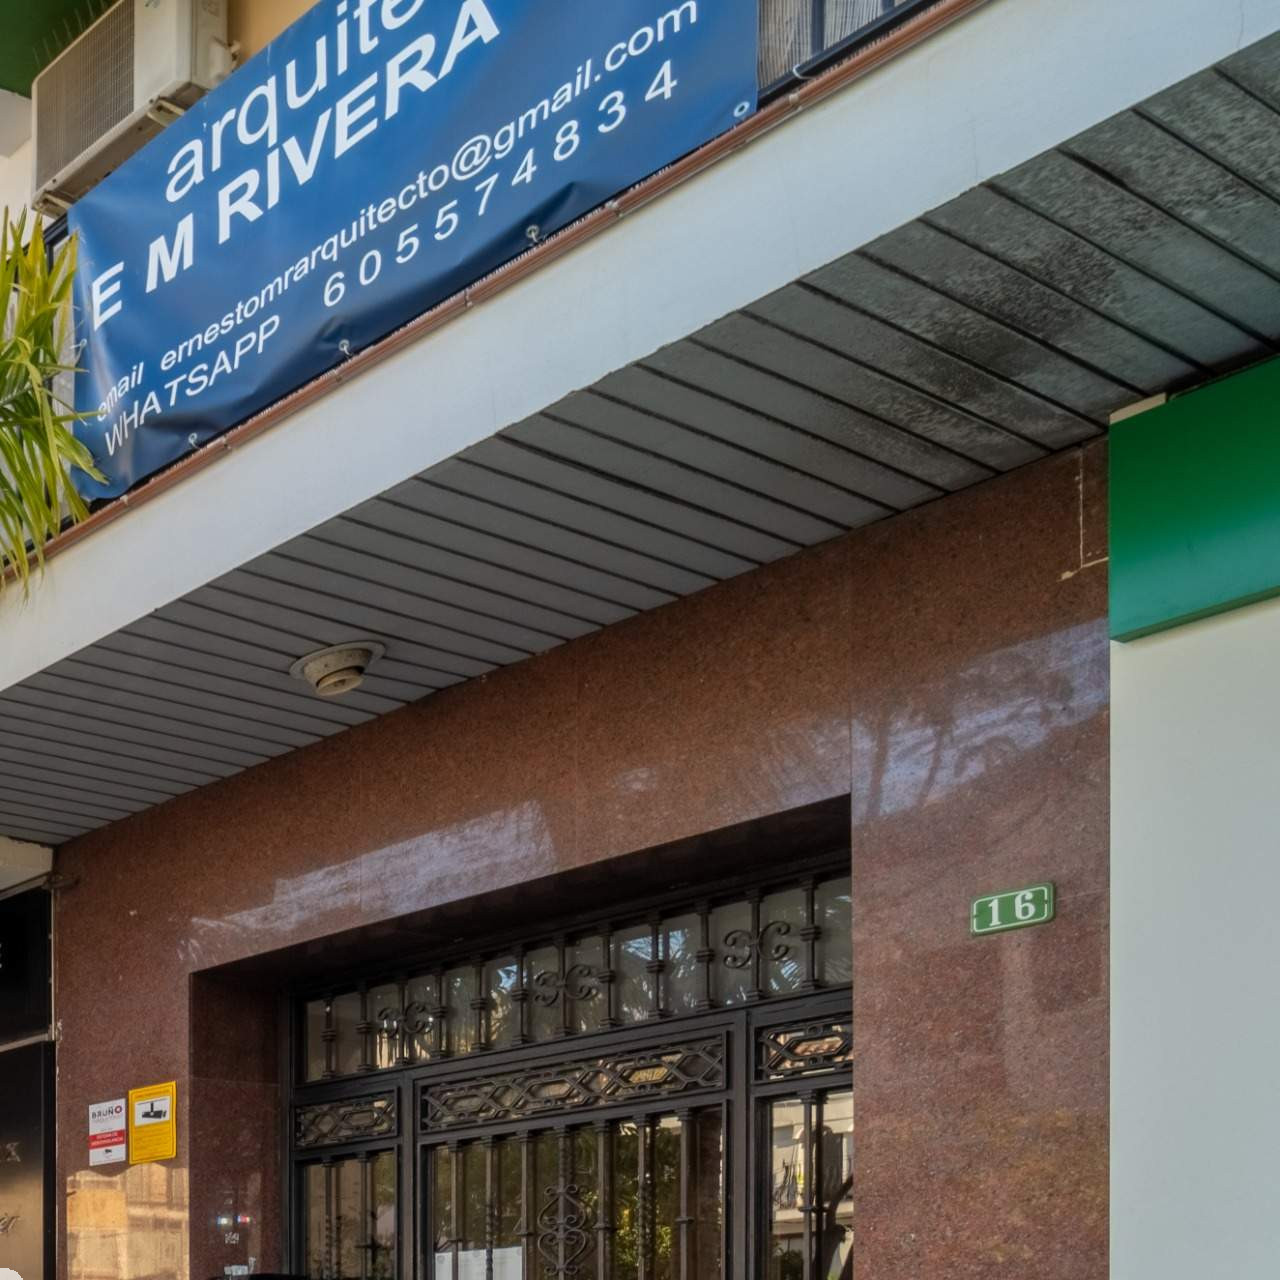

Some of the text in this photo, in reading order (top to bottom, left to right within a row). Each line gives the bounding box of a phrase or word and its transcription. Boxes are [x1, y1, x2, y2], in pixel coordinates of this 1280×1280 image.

[91, 0, 500, 331] E M RIVERA
[96, 0, 698, 422] email ernestomrarquitecto@gmail.com
[104, 315, 281, 457] WHATSAPP
[988, 891, 1036, 926] 16
